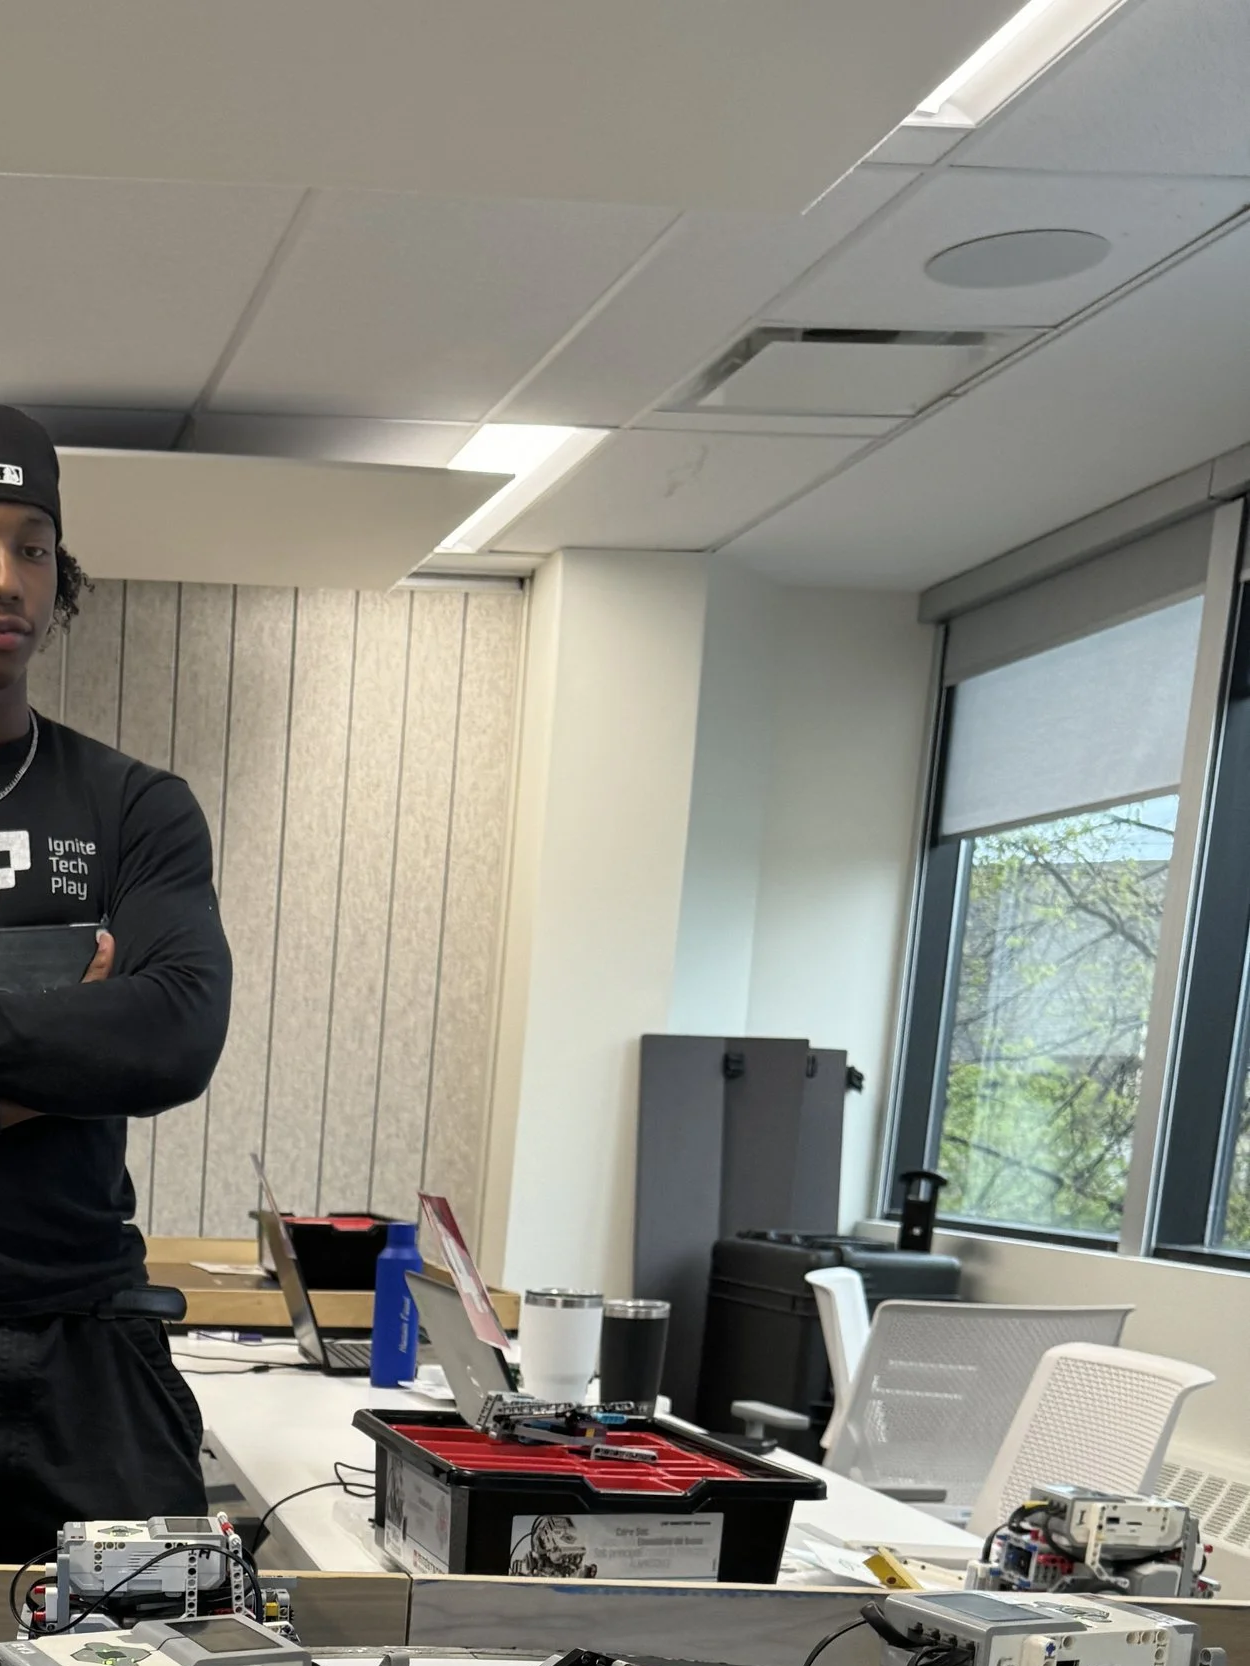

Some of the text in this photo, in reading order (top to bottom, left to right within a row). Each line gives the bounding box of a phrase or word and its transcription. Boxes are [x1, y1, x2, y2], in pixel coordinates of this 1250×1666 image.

[48, 836, 97, 856] Ignite
[49, 856, 89, 876] Tech
[51, 877, 88, 901] Play
